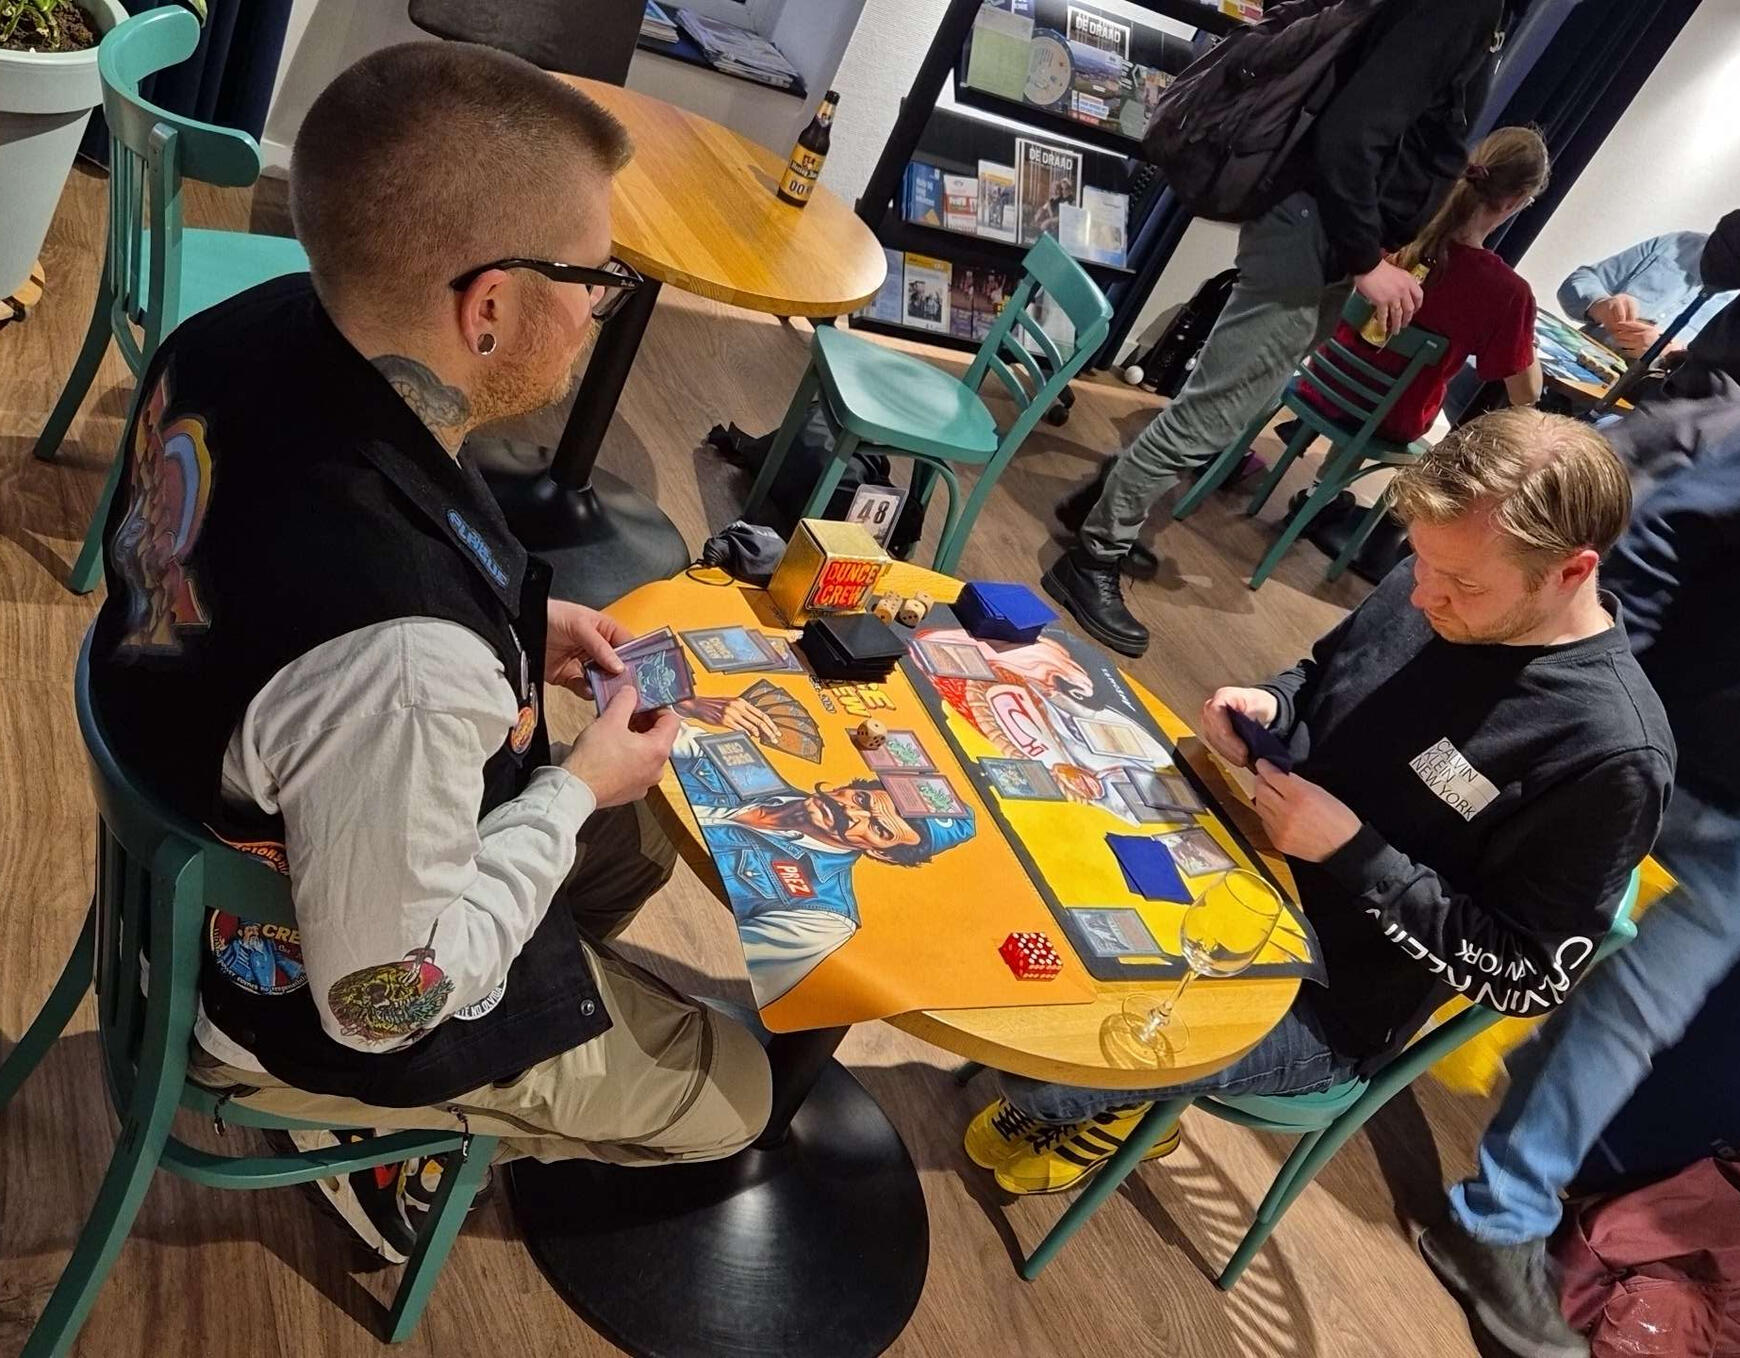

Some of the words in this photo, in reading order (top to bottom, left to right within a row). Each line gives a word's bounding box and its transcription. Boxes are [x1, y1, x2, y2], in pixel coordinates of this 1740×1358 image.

[1089, 21, 1121, 43] DRAAD
[1028, 147, 1042, 162] DE
[1042, 151, 1073, 170] DRAAD
[857, 499, 890, 524] 48
[823, 562, 881, 585] DUNCE
[819, 585, 868, 608] CREW
[1424, 751, 1454, 783] KLEIN
[1436, 739, 1477, 782] CALVIN
[1412, 757, 1439, 787] NEW
[1439, 784, 1476, 819] YORK
[776, 865, 810, 894] PREZ
